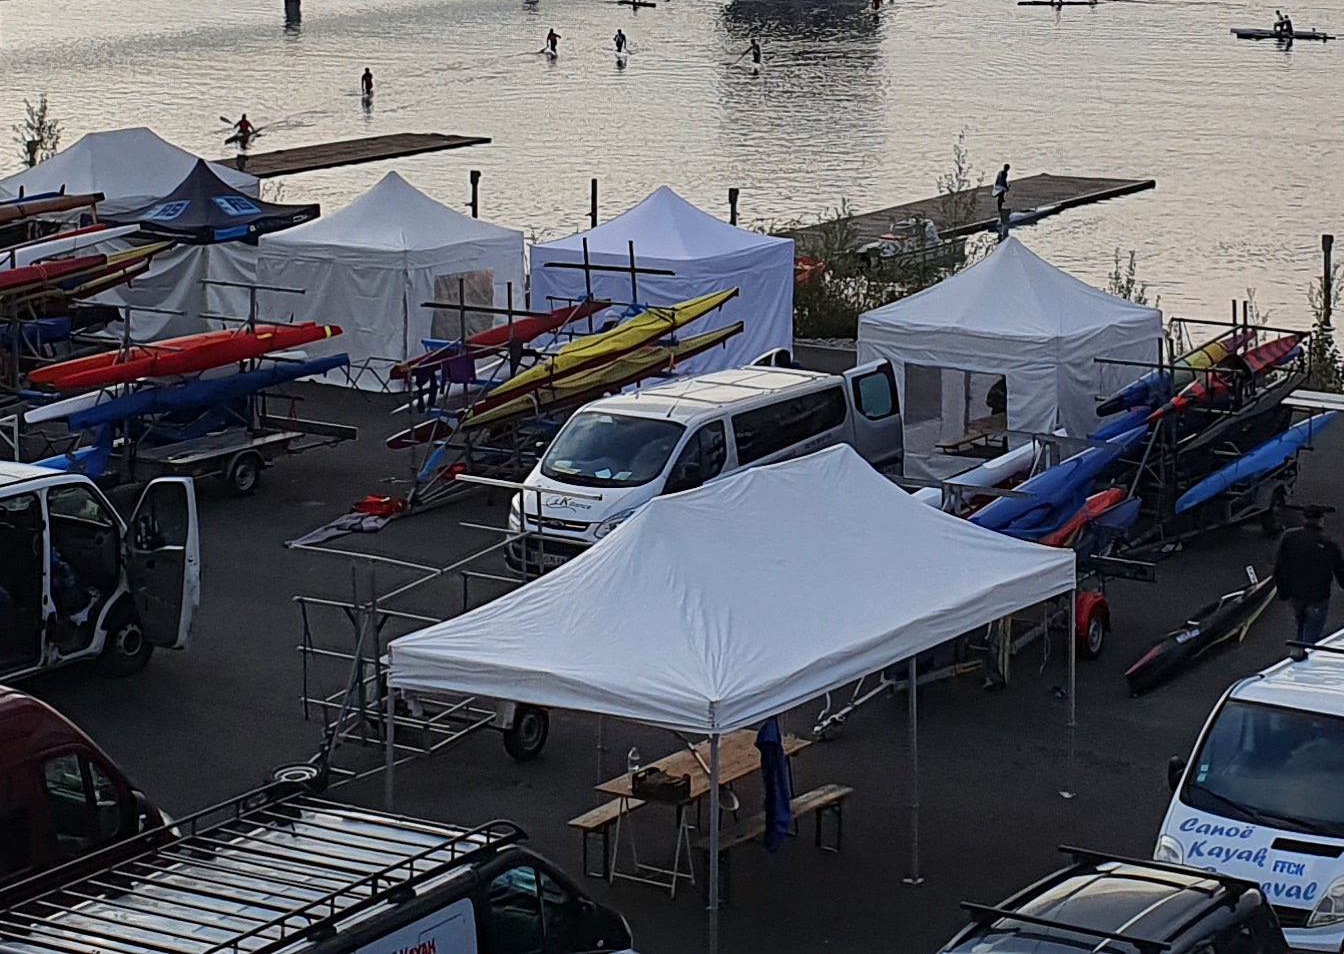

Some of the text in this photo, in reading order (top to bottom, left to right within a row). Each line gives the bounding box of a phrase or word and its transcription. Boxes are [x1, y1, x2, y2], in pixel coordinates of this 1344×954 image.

[1179, 817, 1256, 839] Canoë
[1187, 840, 1268, 868] Kayak
[1272, 859, 1306, 877] FFCK
